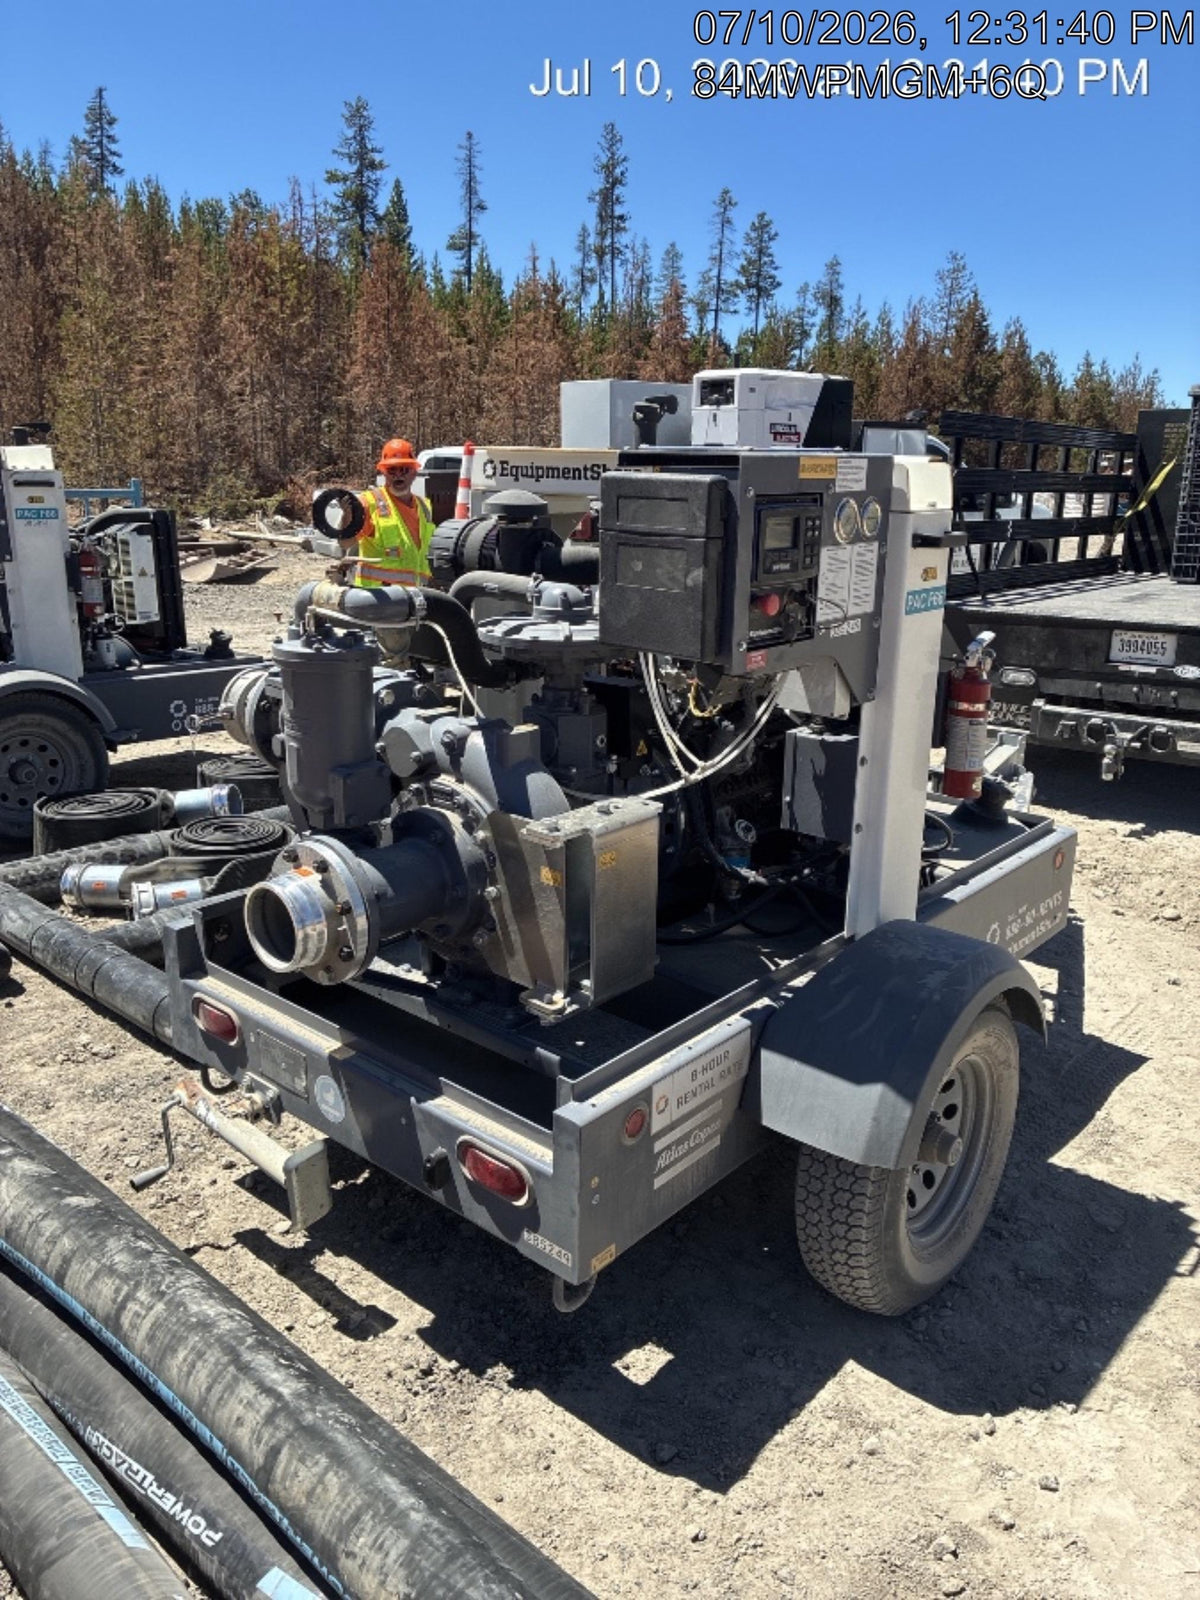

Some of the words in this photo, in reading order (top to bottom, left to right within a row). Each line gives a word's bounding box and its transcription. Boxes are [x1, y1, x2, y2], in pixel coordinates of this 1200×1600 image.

[691, 1049, 730, 1082] 8-HOUR
[676, 1077, 716, 1109] RENTAL
[719, 1059, 745, 1082] RATE
[655, 1141, 689, 1175] Atlas
